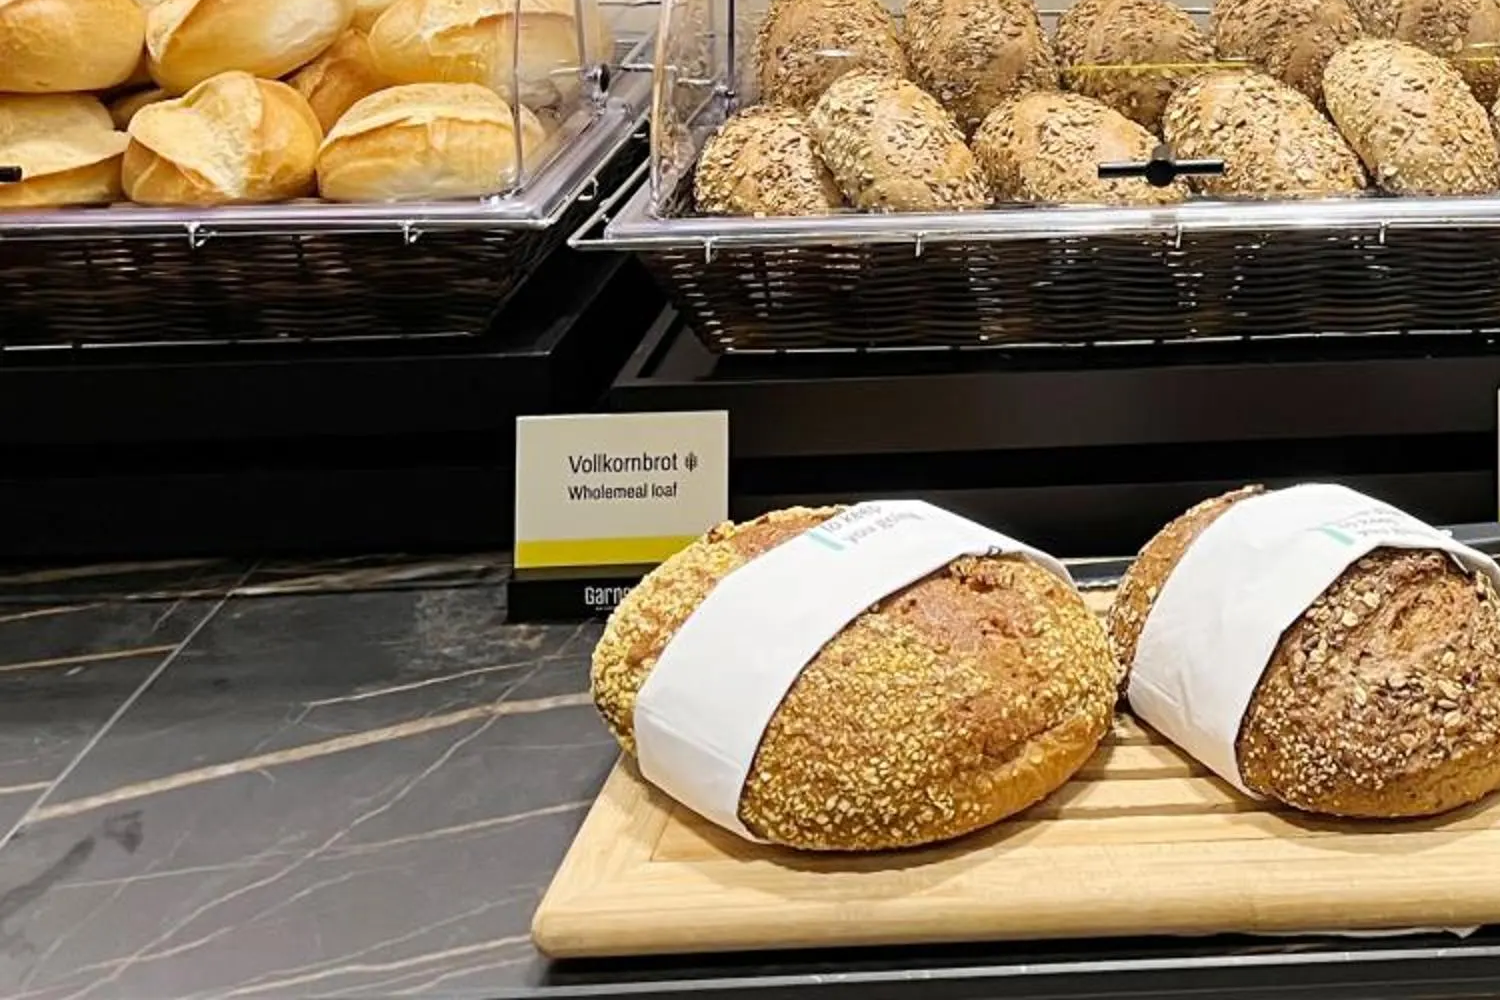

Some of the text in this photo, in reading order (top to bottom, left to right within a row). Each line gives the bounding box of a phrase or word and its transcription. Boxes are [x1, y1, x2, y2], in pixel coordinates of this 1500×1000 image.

[568, 452, 678, 474] Vollkornbrot
[568, 482, 678, 501] Wholemeal loaf
